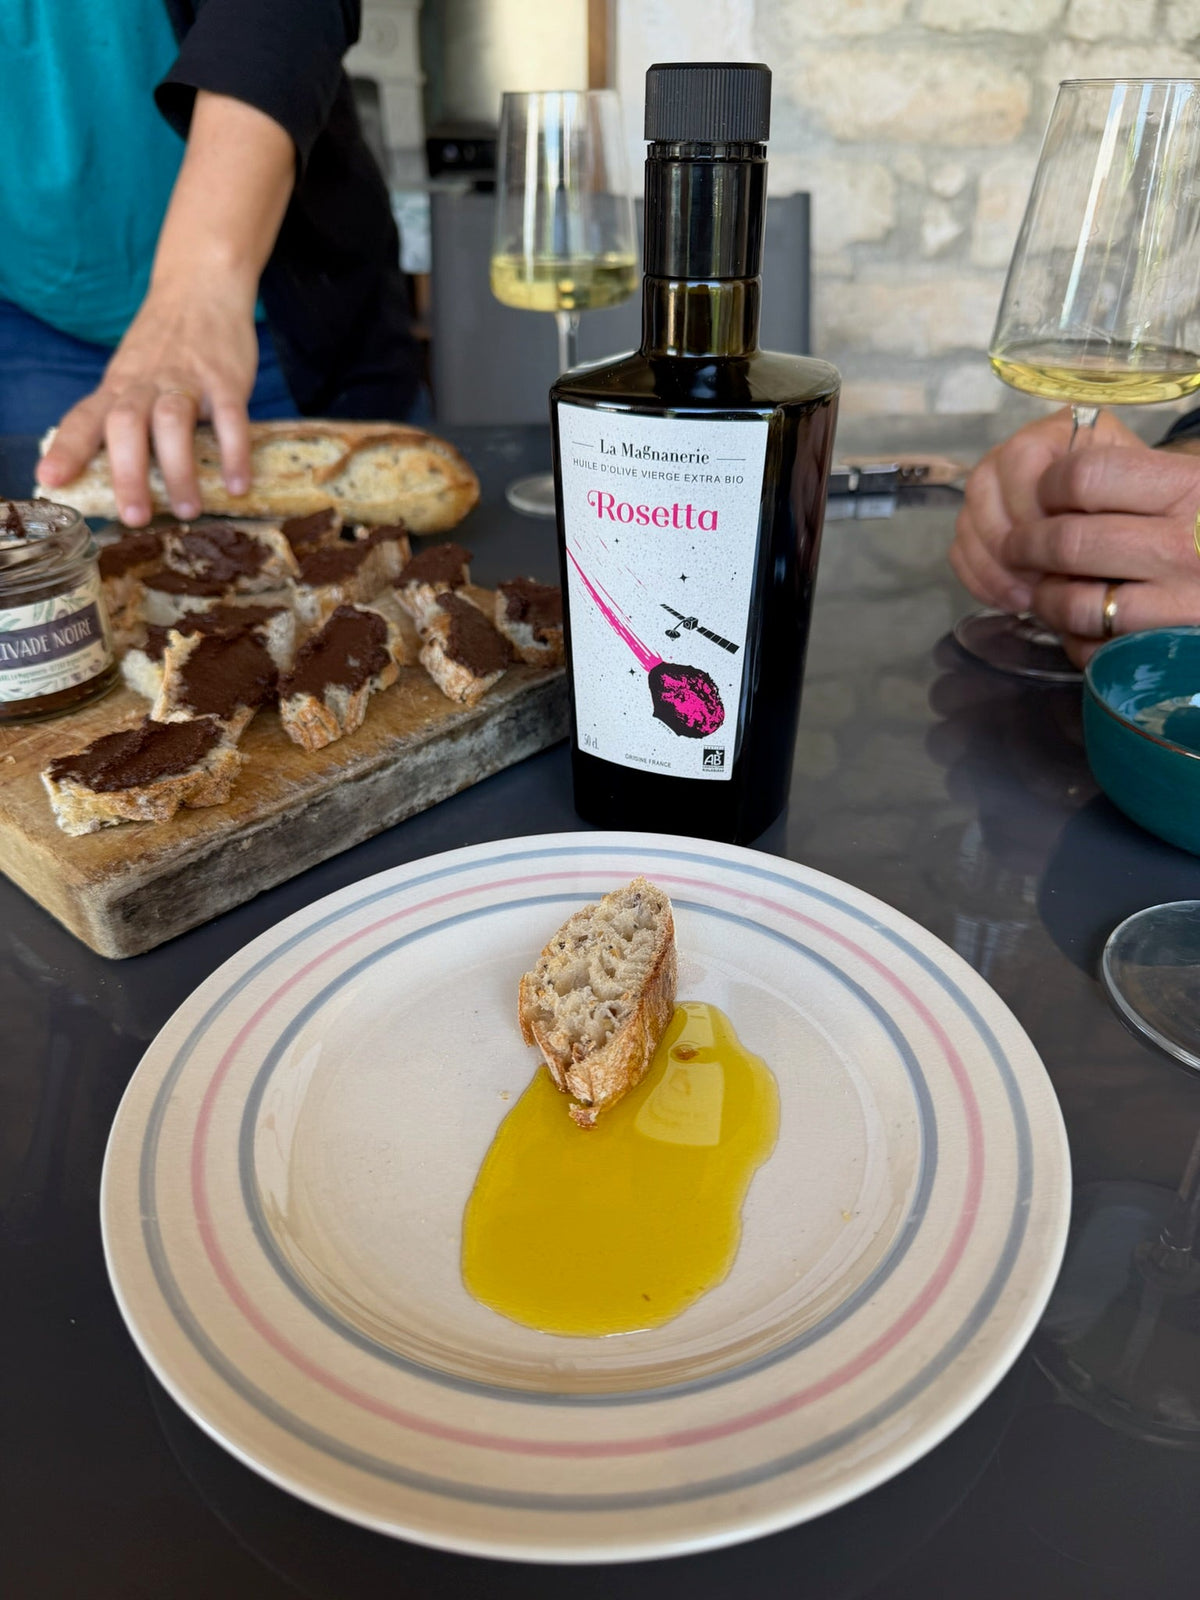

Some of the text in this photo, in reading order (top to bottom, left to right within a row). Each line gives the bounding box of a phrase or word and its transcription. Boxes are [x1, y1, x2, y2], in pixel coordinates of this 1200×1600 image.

[600, 439, 710, 465] La Magnanerie
[573, 457, 744, 485] HUILE D'OLIVE VIERGE EXTRA BIO
[586, 489, 719, 531] Rosetta
[0, 617, 92, 662] IVADE NOIRE
[624, 753, 672, 768] ORIGINE FRANCE
[704, 753, 722, 766] AB
